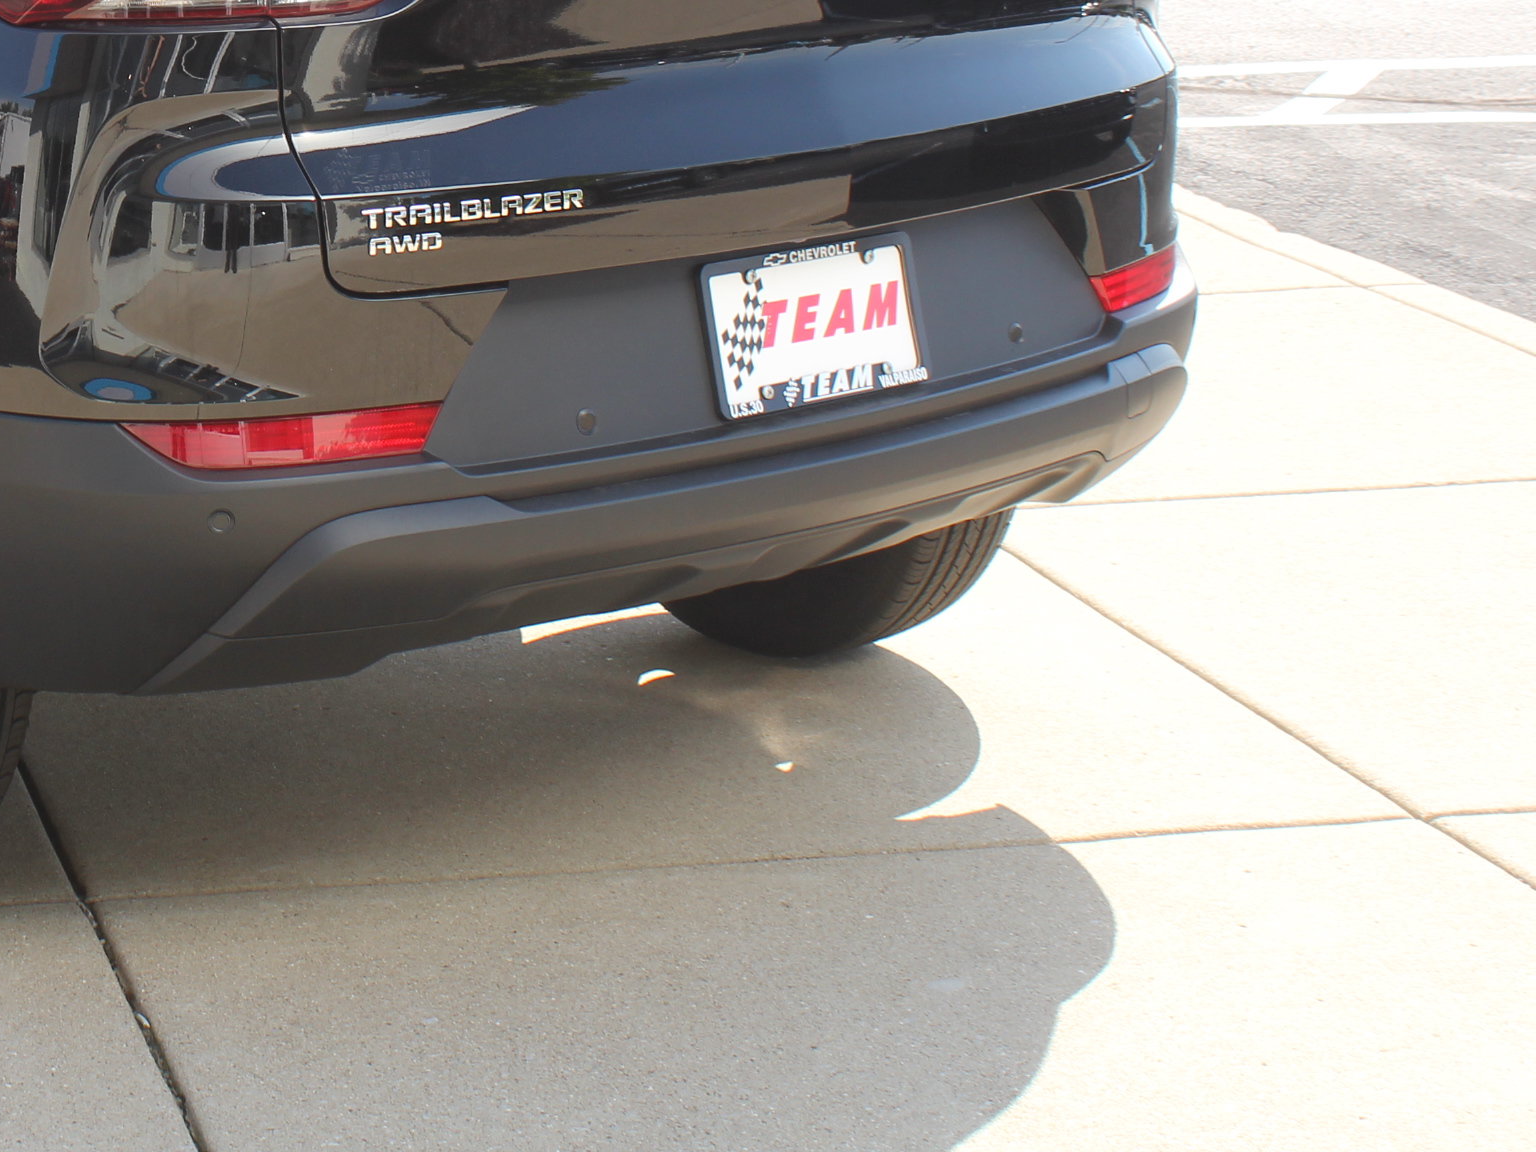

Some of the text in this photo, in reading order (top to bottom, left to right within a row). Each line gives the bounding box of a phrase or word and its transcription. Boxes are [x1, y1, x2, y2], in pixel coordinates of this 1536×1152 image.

[361, 188, 585, 230] TRAILBLAZER
[368, 232, 444, 257] AWD
[789, 241, 857, 263] CHEVROLET
[761, 280, 899, 349] TEAM
[800, 364, 874, 400] TEAM
[878, 366, 928, 389] VALPARAISO
